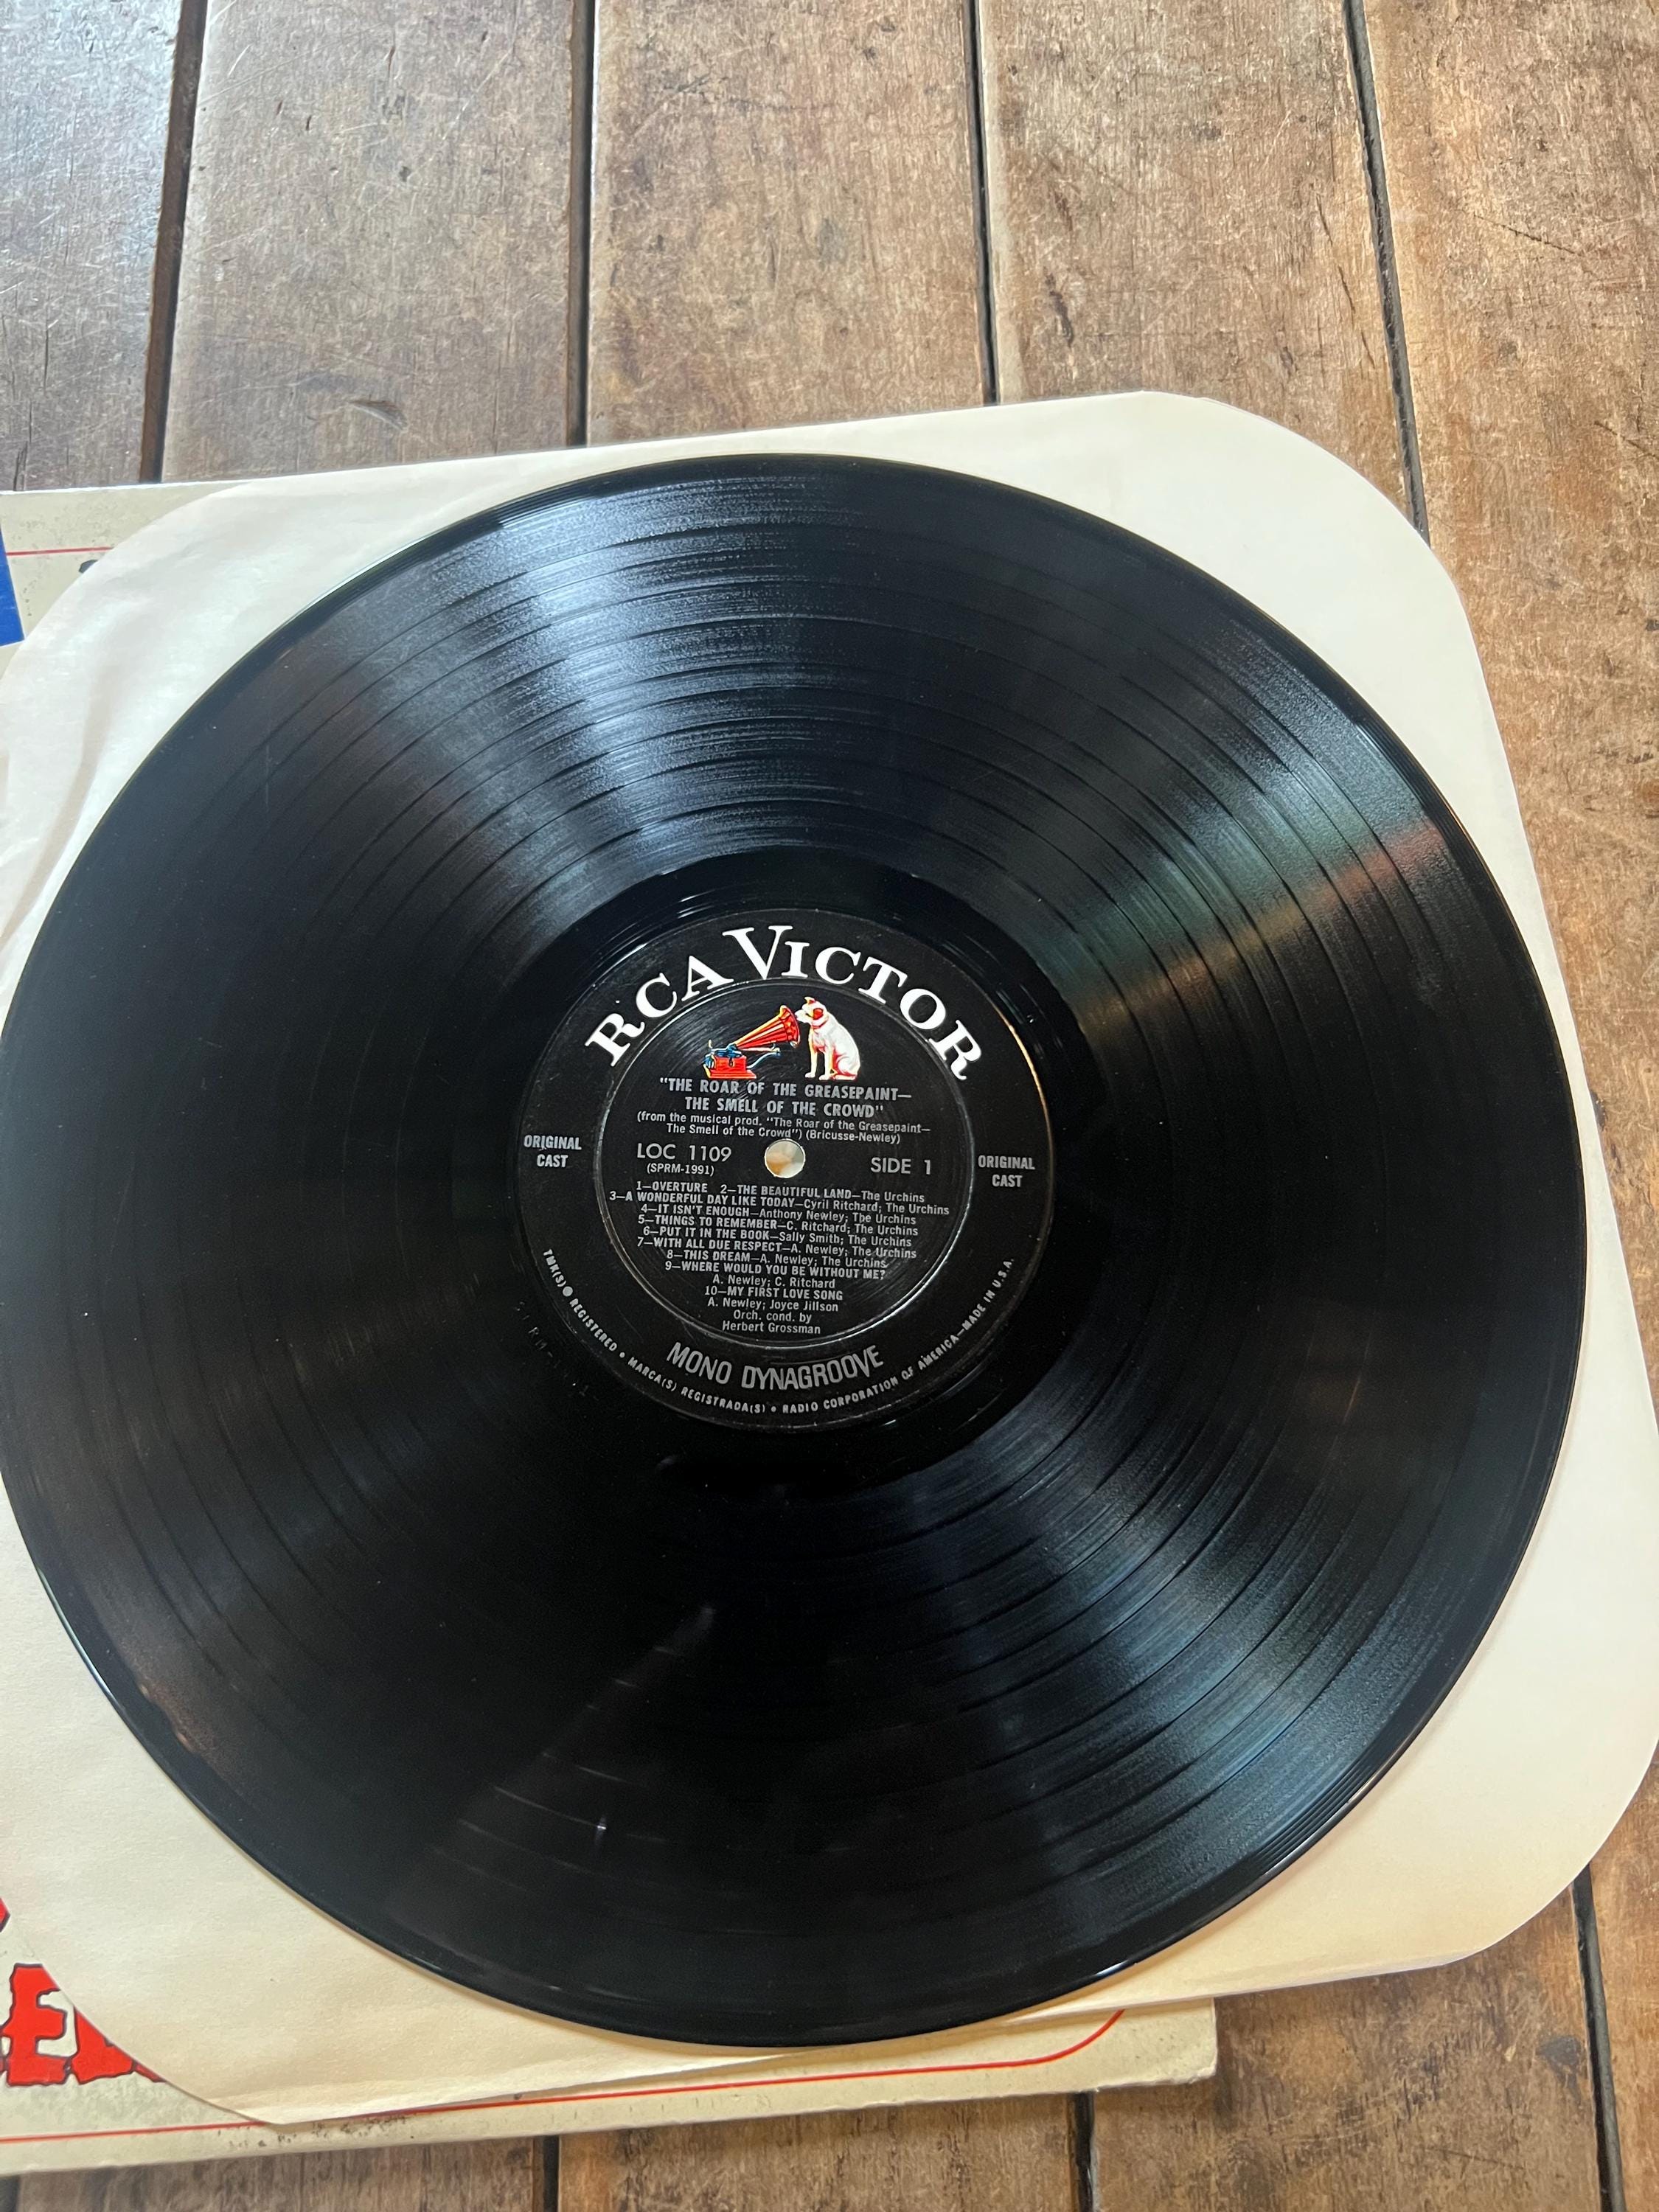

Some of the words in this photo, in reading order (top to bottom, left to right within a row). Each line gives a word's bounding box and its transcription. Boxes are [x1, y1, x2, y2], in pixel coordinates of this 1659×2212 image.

[585, 954, 734, 1067] RCA
[723, 925, 984, 1080] VICTOR
[700, 1079, 738, 1093] ROAR
[747, 1082, 765, 1095] OF
[773, 1082, 796, 1096] THE
[686, 1097, 709, 1110] THE
[717, 1099, 758, 1113] SMELL
[767, 1101, 784, 1113] OF
[792, 1102, 815, 1115] THE
[637, 1111, 666, 1122] (from
[670, 1113, 686, 1122] the
[691, 1115, 731, 1124] musical
[734, 1116, 762, 1126] prod.
[767, 1117, 792, 1127] "The
[796, 1119, 818, 1127] Roar
[824, 1119, 834, 1129] of
[838, 1120, 855, 1130] the
[524, 1135, 582, 1150] ORIGINAL
[667, 1124, 685, 1133] The
[689, 1124, 718, 1135] Smell
[723, 1125, 734, 1135] of
[738, 1127, 754, 1136] the
[759, 1127, 802, 1140] Crowd")
[806, 1130, 900, 1144] (Bricusse-Newley)
[537, 1154, 568, 1167] CAST
[637, 1143, 675, 1159] LOC
[689, 1144, 731, 1162] 1109
[647, 1163, 714, 1177] (SPRM-1991)
[870, 1157, 911, 1174] SIDE
[924, 1160, 931, 1175] 1
[978, 1155, 1035, 1169] ORIGINAL
[992, 1174, 1023, 1187] CAST
[637, 1192, 703, 1204] WONDERFUL
[707, 1194, 728, 1205] DAY
[731, 1195, 757, 1206] LIKE
[833, 1200, 882, 1213] Ritchard;
[886, 1203, 905, 1213] The
[908, 1204, 949, 1214] Urchins
[761, 1186, 820, 1198] BEAUTIFUL
[885, 1192, 925, 1203] Urchins
[700, 1217, 712, 1226] TO
[801, 1221, 850, 1234] Ritchard;
[855, 1224, 873, 1234] The
[877, 1225, 918, 1236] Urchins
[807, 1211, 848, 1222] Newley;
[852, 1212, 872, 1222] The
[876, 1214, 917, 1225] Urchins
[686, 1228, 696, 1237] IT
[700, 1228, 712, 1237] IN
[717, 1229, 737, 1239] THE
[810, 1234, 844, 1245] Smith;
[849, 1234, 866, 1245] The
[871, 1236, 911, 1247] Urchins
[686, 1239, 704, 1248] ALL
[709, 1239, 730, 1250] DUE
[806, 1245, 847, 1257] Newley;
[852, 1246, 871, 1256] The
[876, 1248, 917, 1259] Urchins
[775, 1254, 817, 1267] Newley;
[822, 1256, 841, 1266] The
[845, 1257, 886, 1267] Urchins
[724, 1263, 762, 1273] WOULD
[766, 1265, 787, 1275] YOU
[792, 1266, 805, 1276] BE
[810, 1267, 860, 1278] WITHOUT
[863, 1269, 886, 1280] ME?
[713, 1274, 723, 1284] A.
[728, 1275, 771, 1287] Newley;
[775, 1276, 785, 1286] C.
[790, 1278, 835, 1289] Ritchard
[748, 1287, 779, 1298] FIRST
[783, 1288, 810, 1300] LOVE
[814, 1290, 844, 1301] SONG
[708, 1297, 718, 1307] A.
[723, 1298, 765, 1310] Newley;
[769, 1298, 799, 1311] Joyce
[803, 1301, 838, 1312] Jillson
[734, 1310, 762, 1320] Orch.
[766, 1311, 795, 1322] cond.
[799, 1313, 812, 1324] by
[569, 1298, 617, 1352] REGISTERED
[628, 1357, 677, 1391] MARCA(S)
[681, 1387, 765, 1413] REGISTRADA(S)
[783, 1402, 818, 1413] RADIO
[824, 1377, 898, 1410] CORPORATION
[902, 1367, 914, 1380] OF
[984, 1290, 995, 1304] IN
[992, 1259, 1014, 1288] U.S.A.
[723, 1321, 764, 1332] Herbert
[768, 1323, 821, 1335] Grossman
[666, 1342, 732, 1385] MONO
[741, 1345, 884, 1390] DYNAGROOVE
